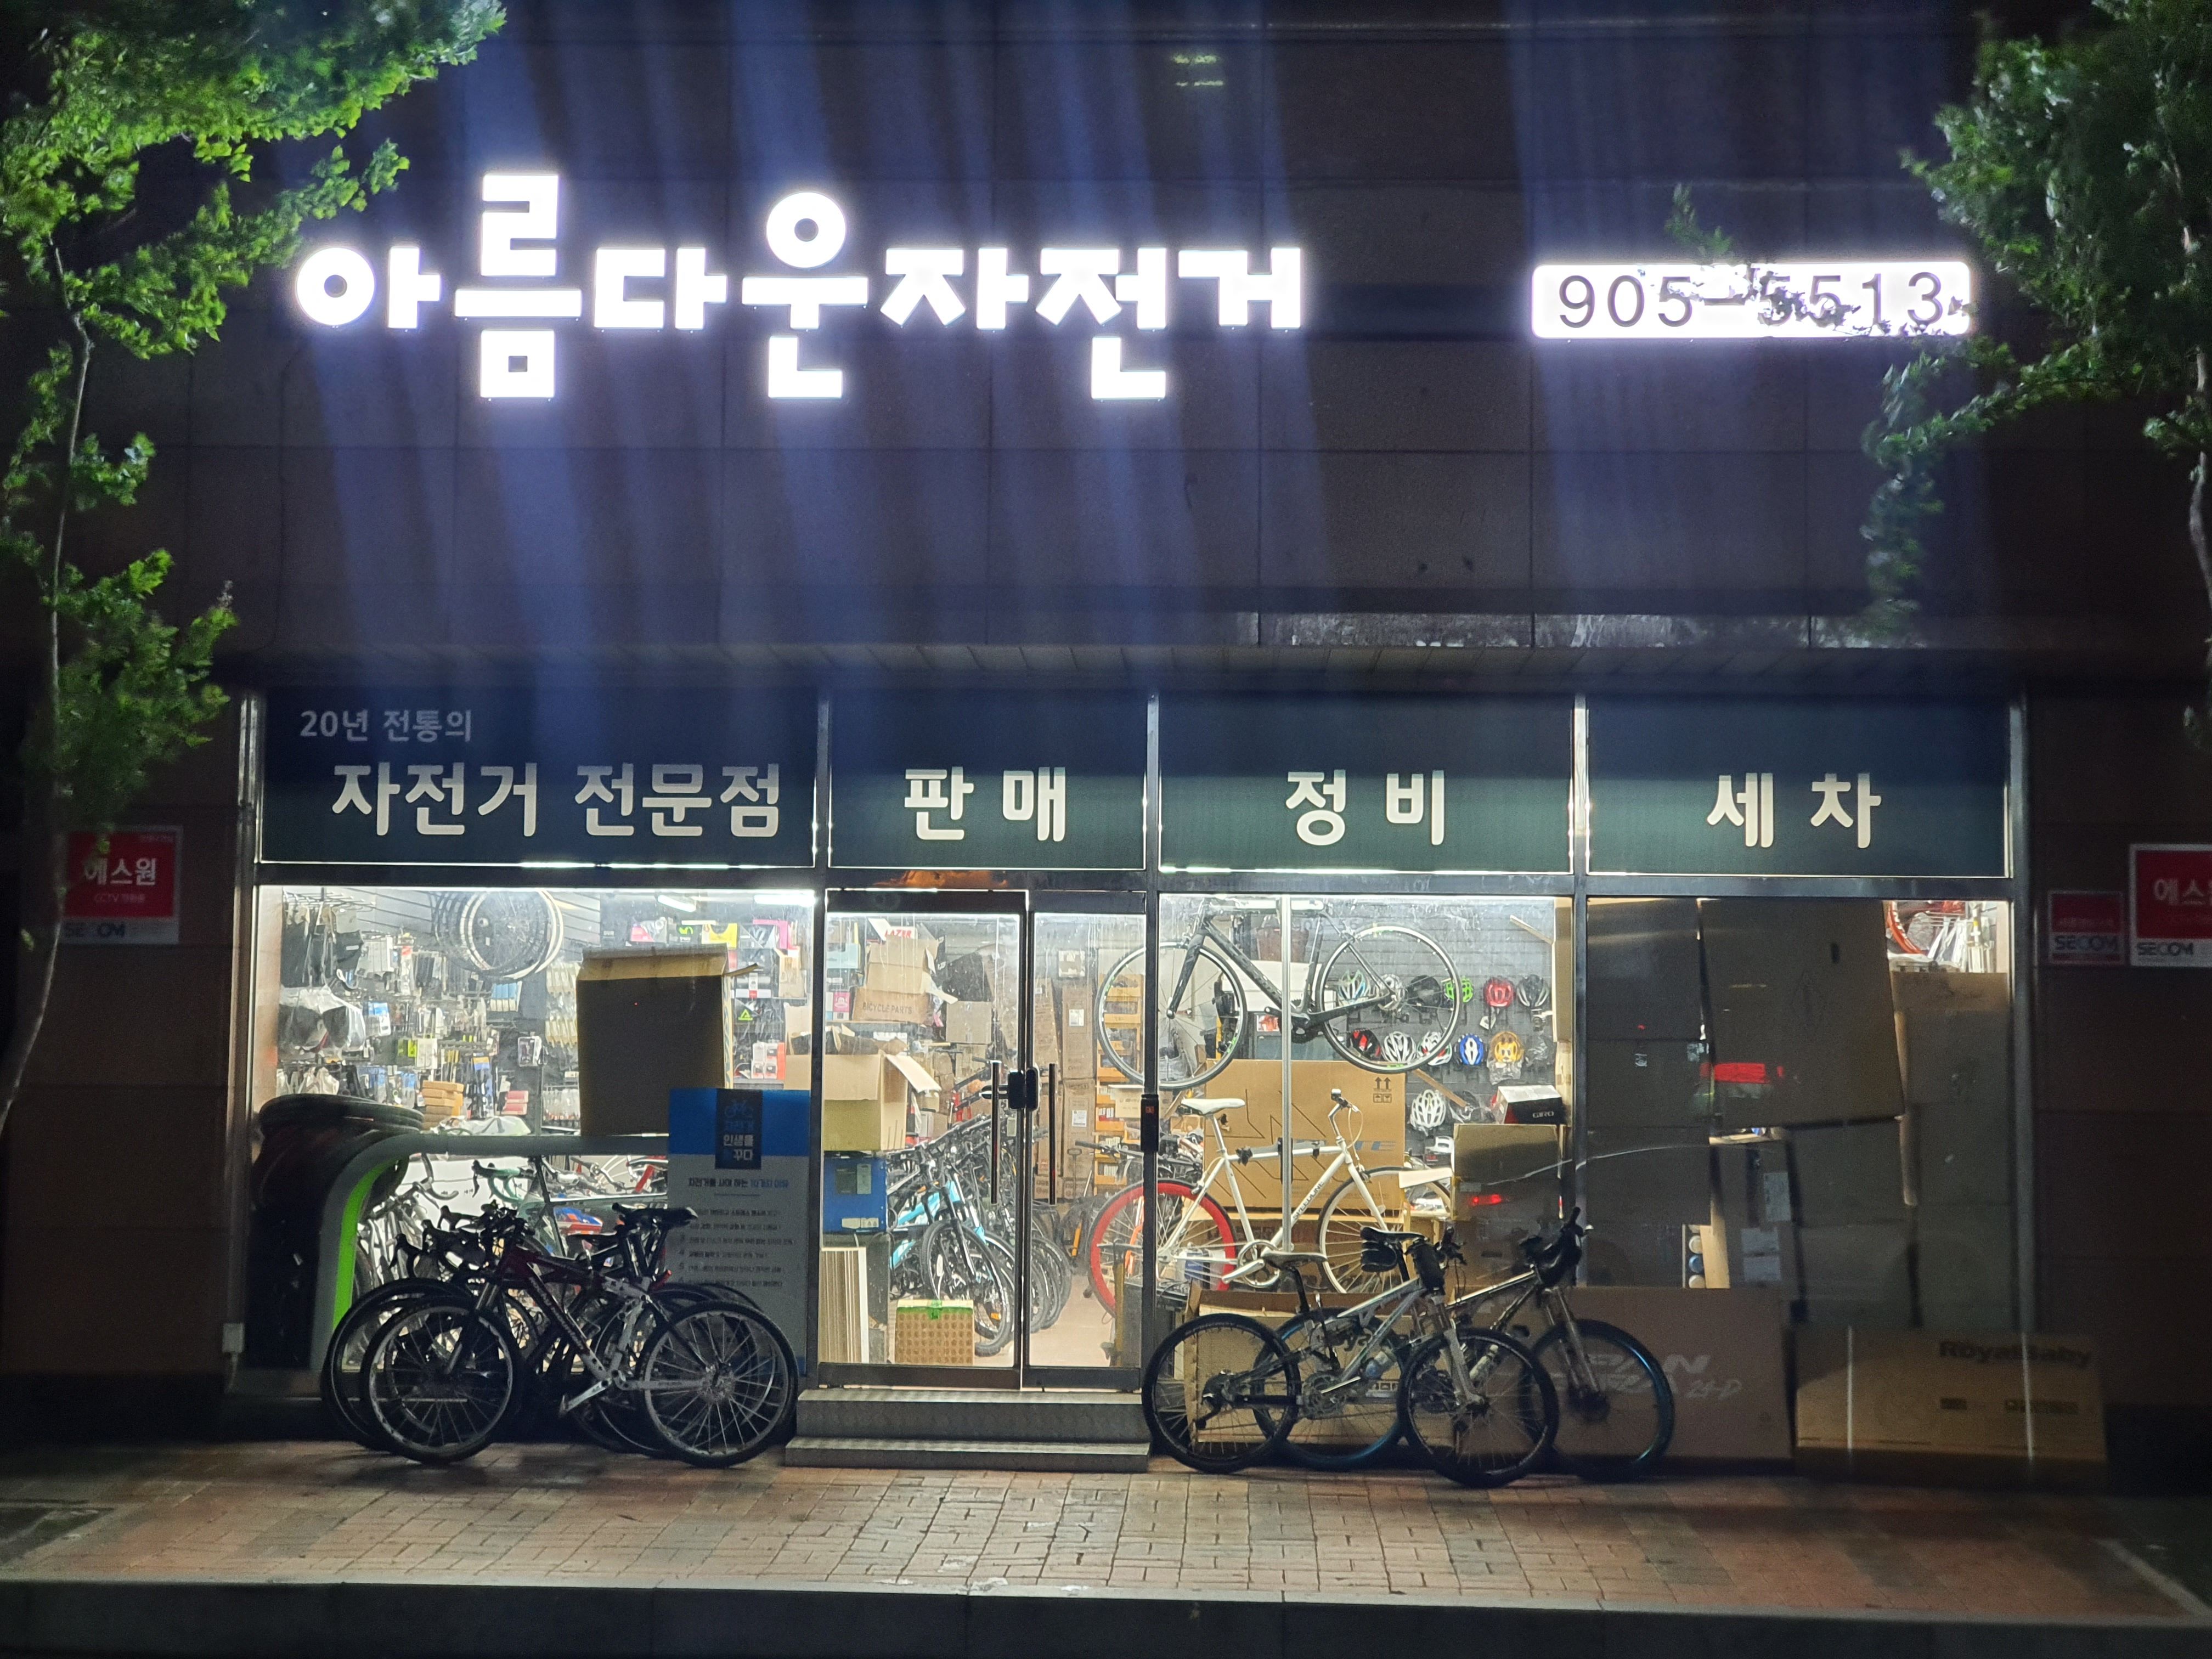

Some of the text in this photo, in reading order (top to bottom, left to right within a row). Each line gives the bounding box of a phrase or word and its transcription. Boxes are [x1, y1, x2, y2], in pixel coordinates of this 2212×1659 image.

[296, 173, 1301, 399] 아름다운자전거
[1559, 272, 1944, 329] 905-5513
[300, 709, 472, 743] 20년 전통의
[331, 761, 780, 838] 자전거 전문점
[83, 857, 157, 886] 에스원
[2154, 878, 2212, 905] 에스
[65, 922, 126, 938] SEOM
[862, 1002, 913, 1015] BICYCLE PARTS
